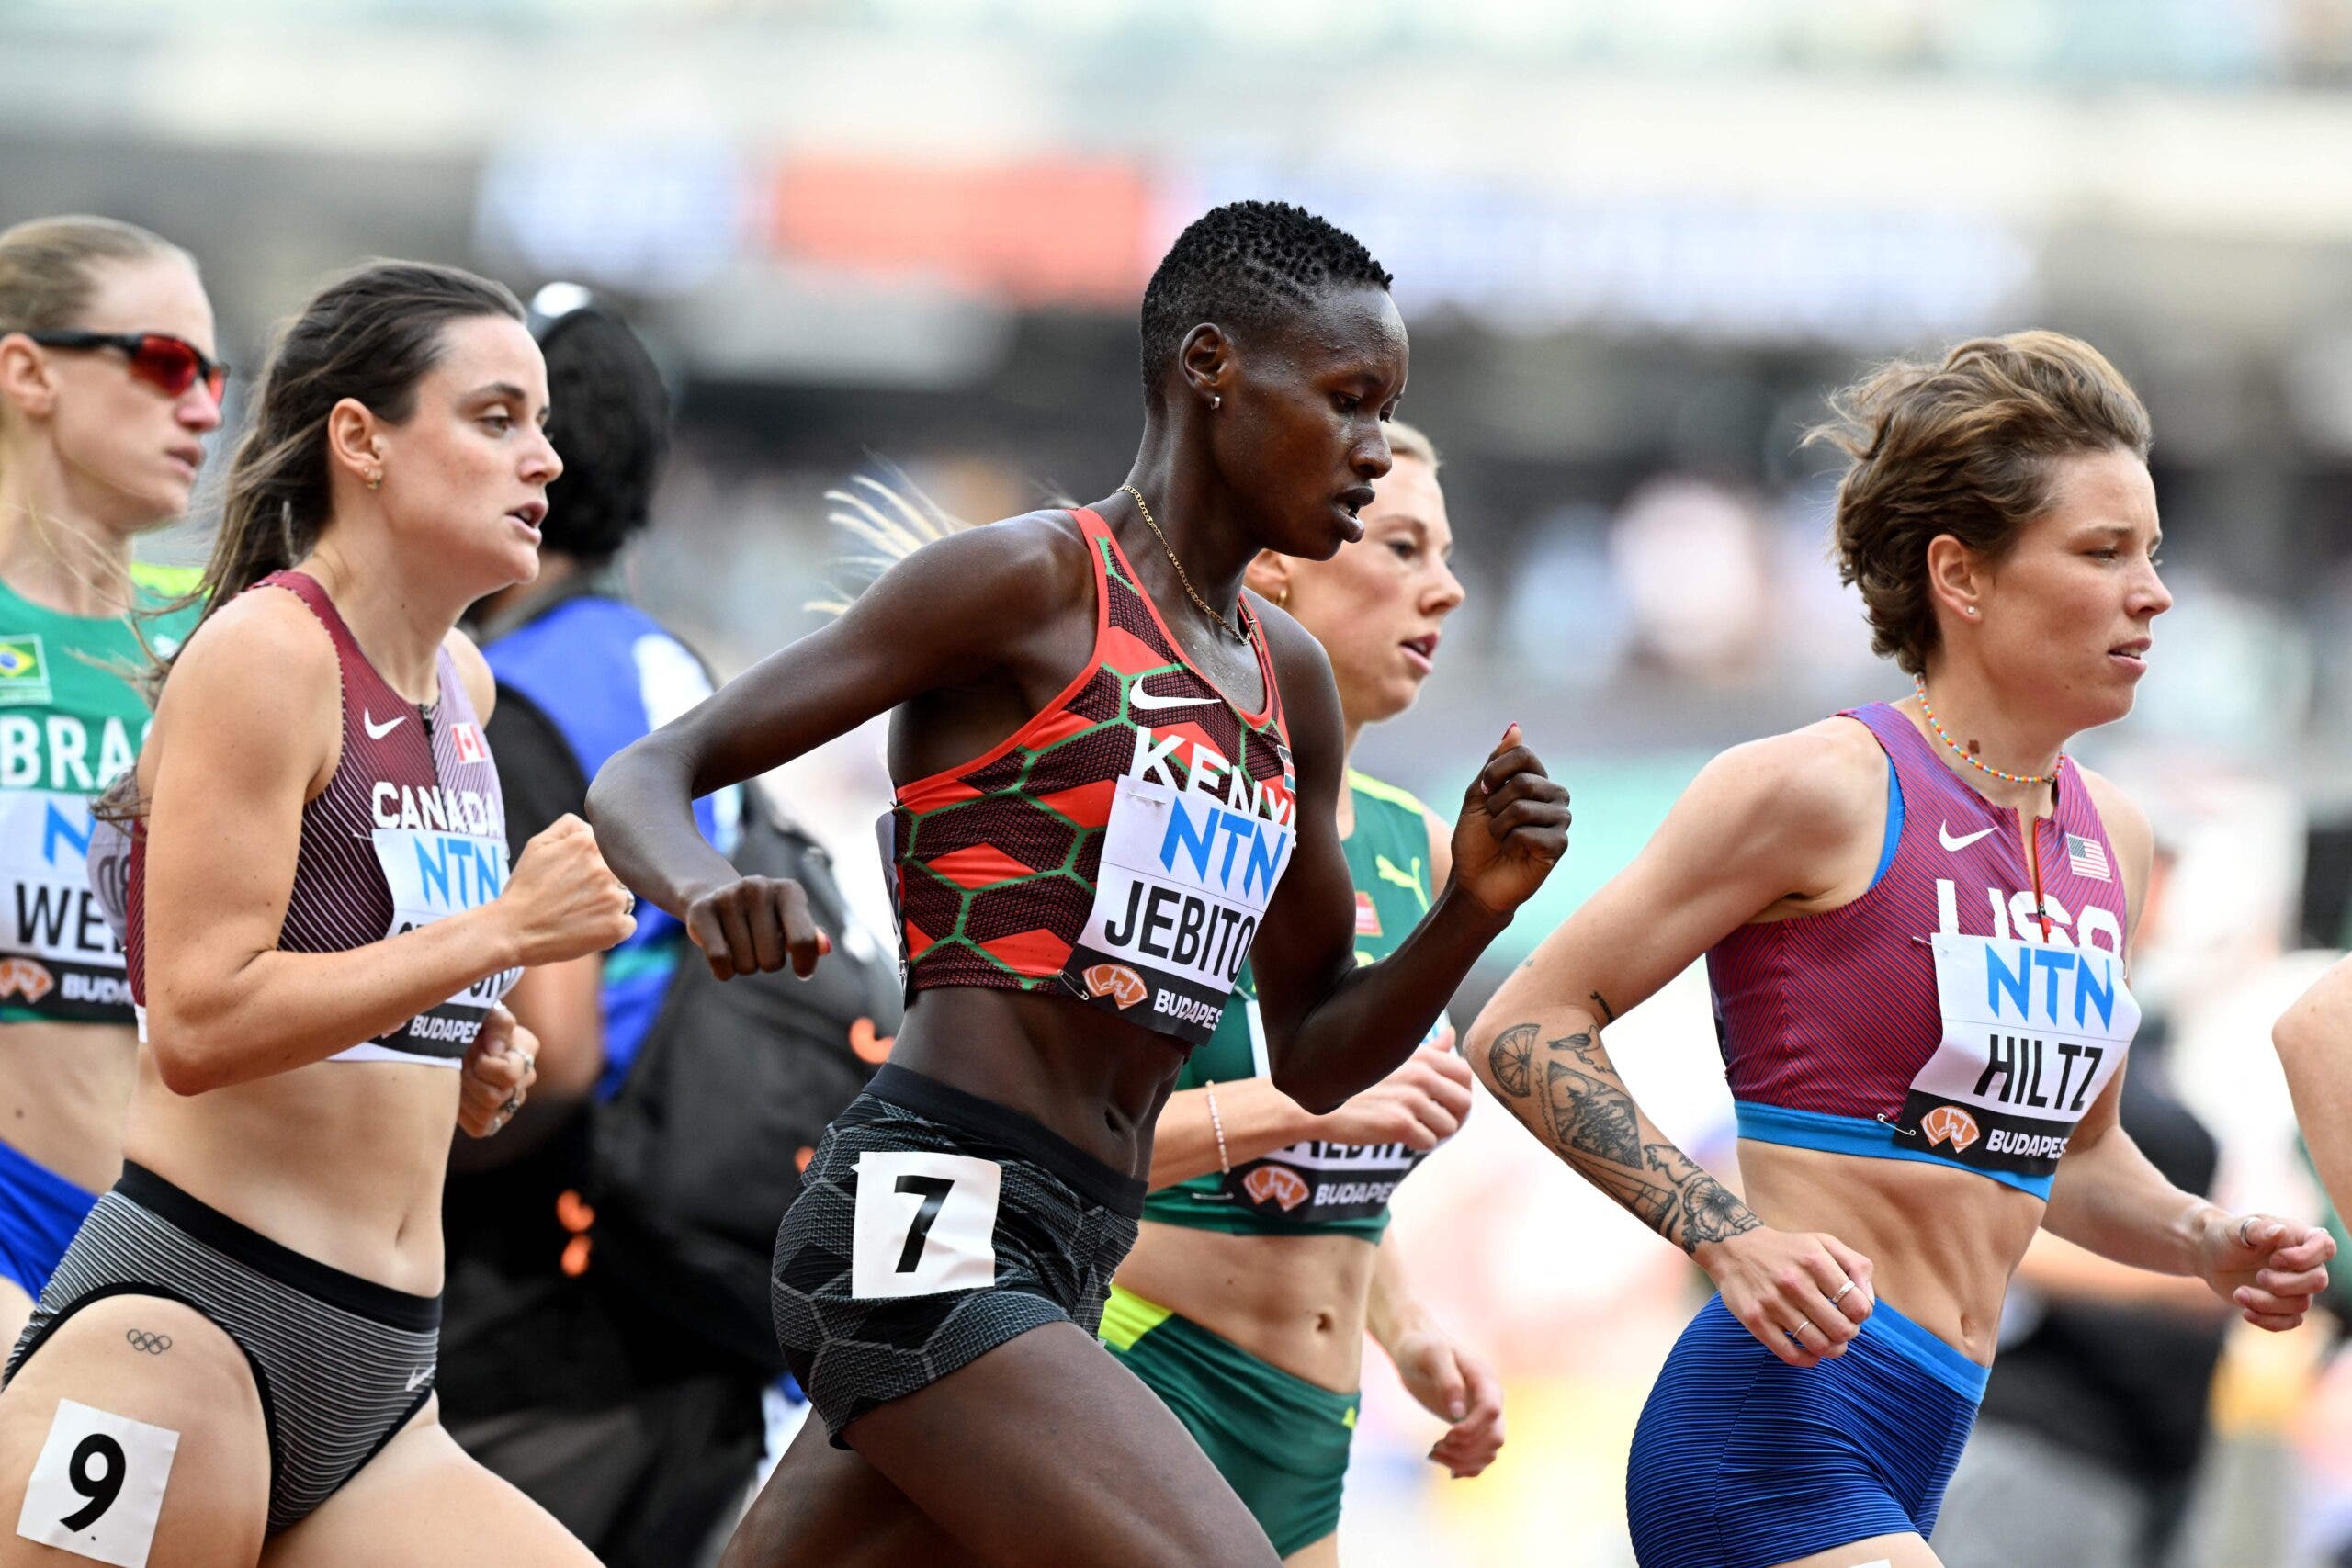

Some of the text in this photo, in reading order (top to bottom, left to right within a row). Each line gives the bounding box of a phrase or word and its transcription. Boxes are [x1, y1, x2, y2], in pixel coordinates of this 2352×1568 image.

[0, 715, 153, 790] BRA
[413, 835, 500, 909] NTN
[1159, 796, 1285, 904] NTN
[16, 882, 126, 953] WE
[1104, 880, 1254, 983] JEBITO
[1985, 942, 2113, 1032] NTN
[1973, 1034, 2104, 1111] HILTZ
[894, 1175, 956, 1273] 7
[59, 1433, 127, 1533] 9
